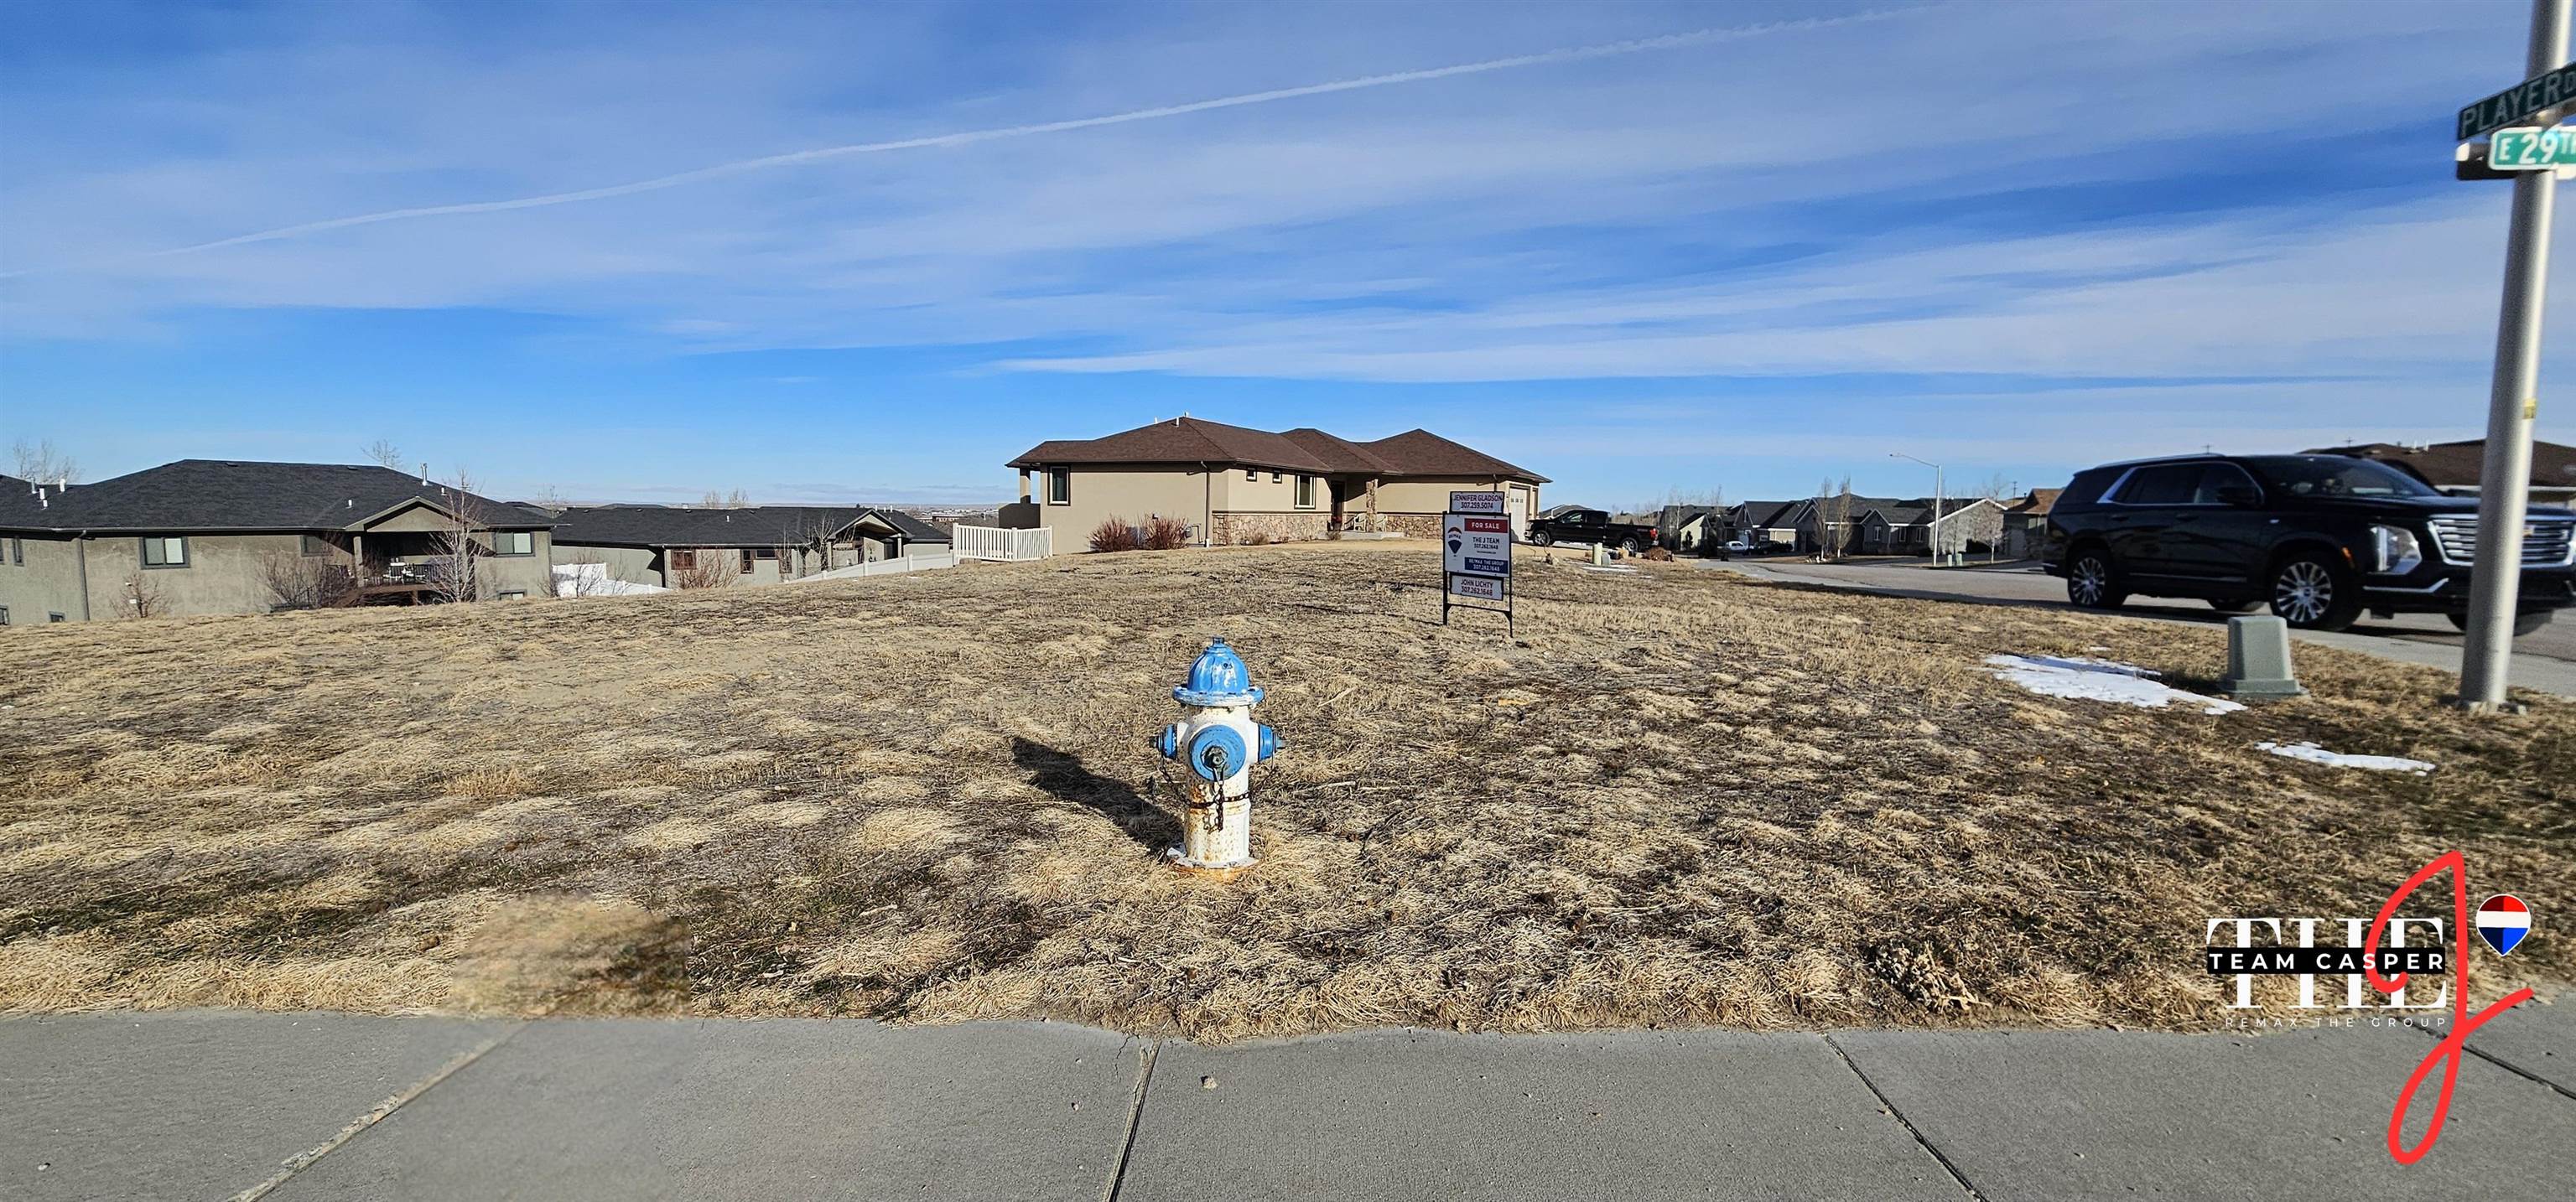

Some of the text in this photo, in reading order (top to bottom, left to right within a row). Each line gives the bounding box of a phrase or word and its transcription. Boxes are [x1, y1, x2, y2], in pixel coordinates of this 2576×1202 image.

[2461, 72, 2562, 140] PLAYER
[2499, 137, 2513, 160] E
[2519, 131, 2559, 163] 29
[1461, 578, 1493, 588] JOHN LICHTY
